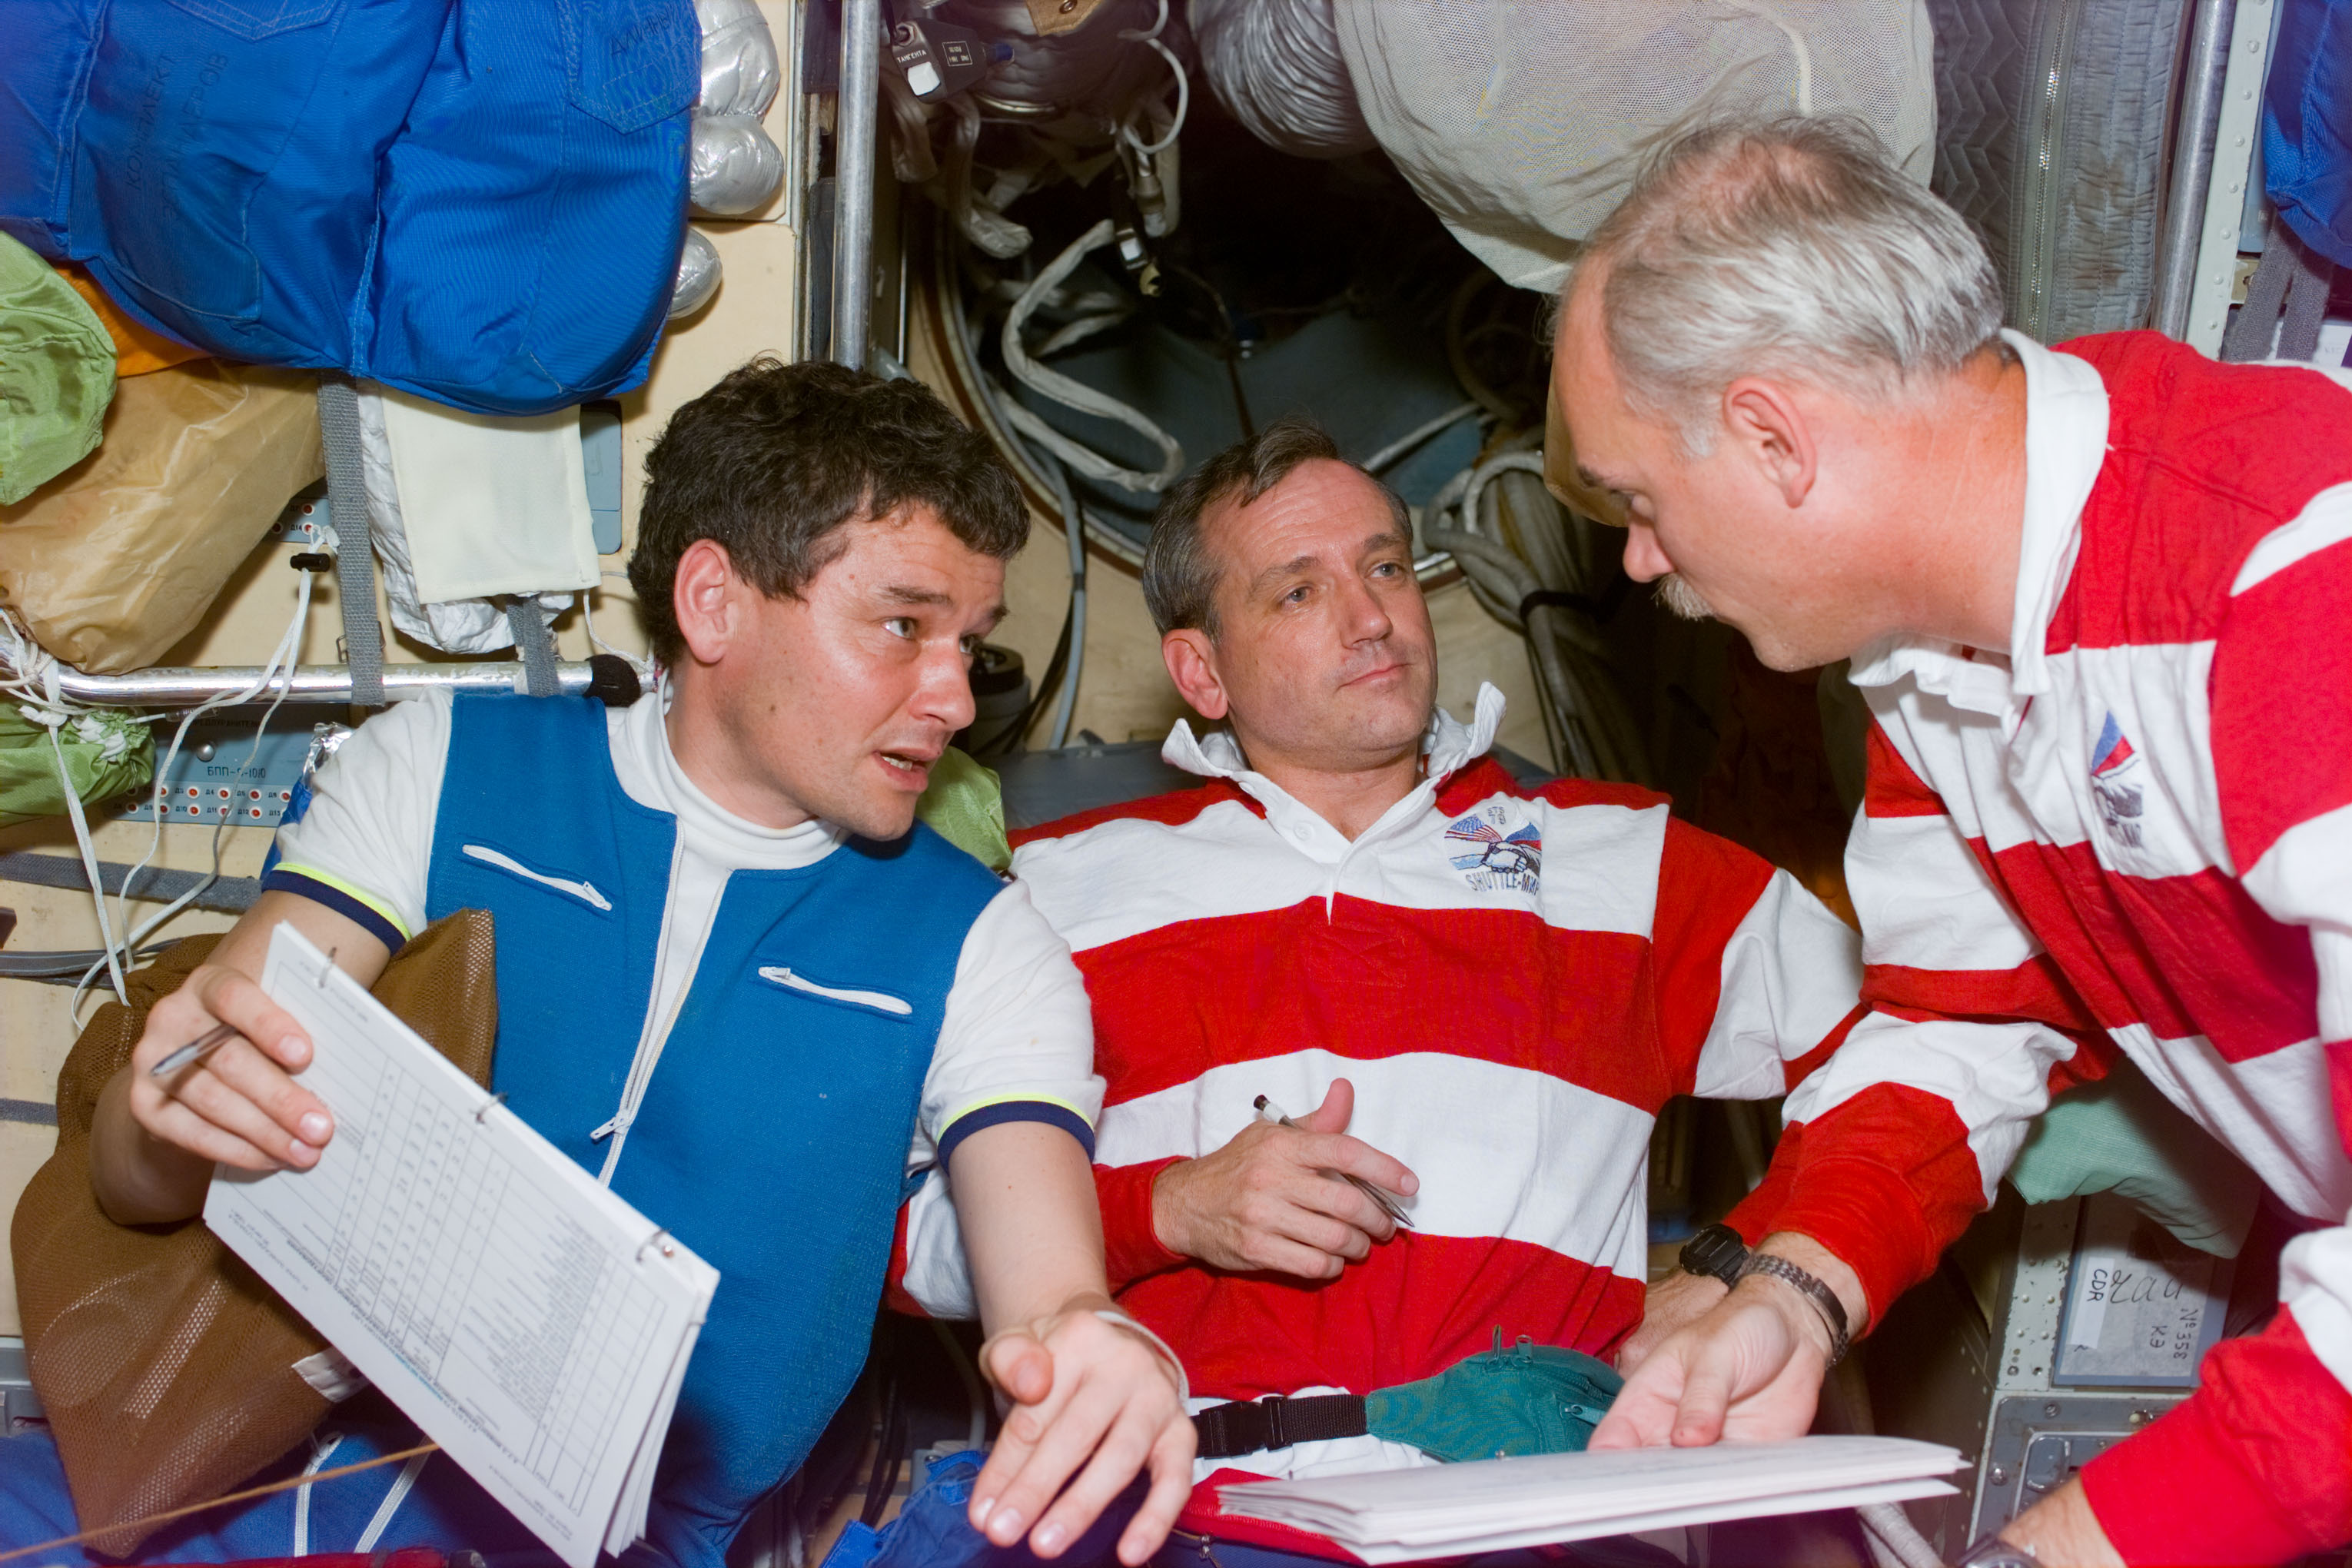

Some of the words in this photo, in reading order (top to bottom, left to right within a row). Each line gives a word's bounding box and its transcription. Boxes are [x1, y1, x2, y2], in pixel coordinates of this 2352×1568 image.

[896, 49, 927, 63] ТАНГЕНТА
[1487, 806, 1505, 815] STS
[2086, 1268, 2108, 1302] CDR
